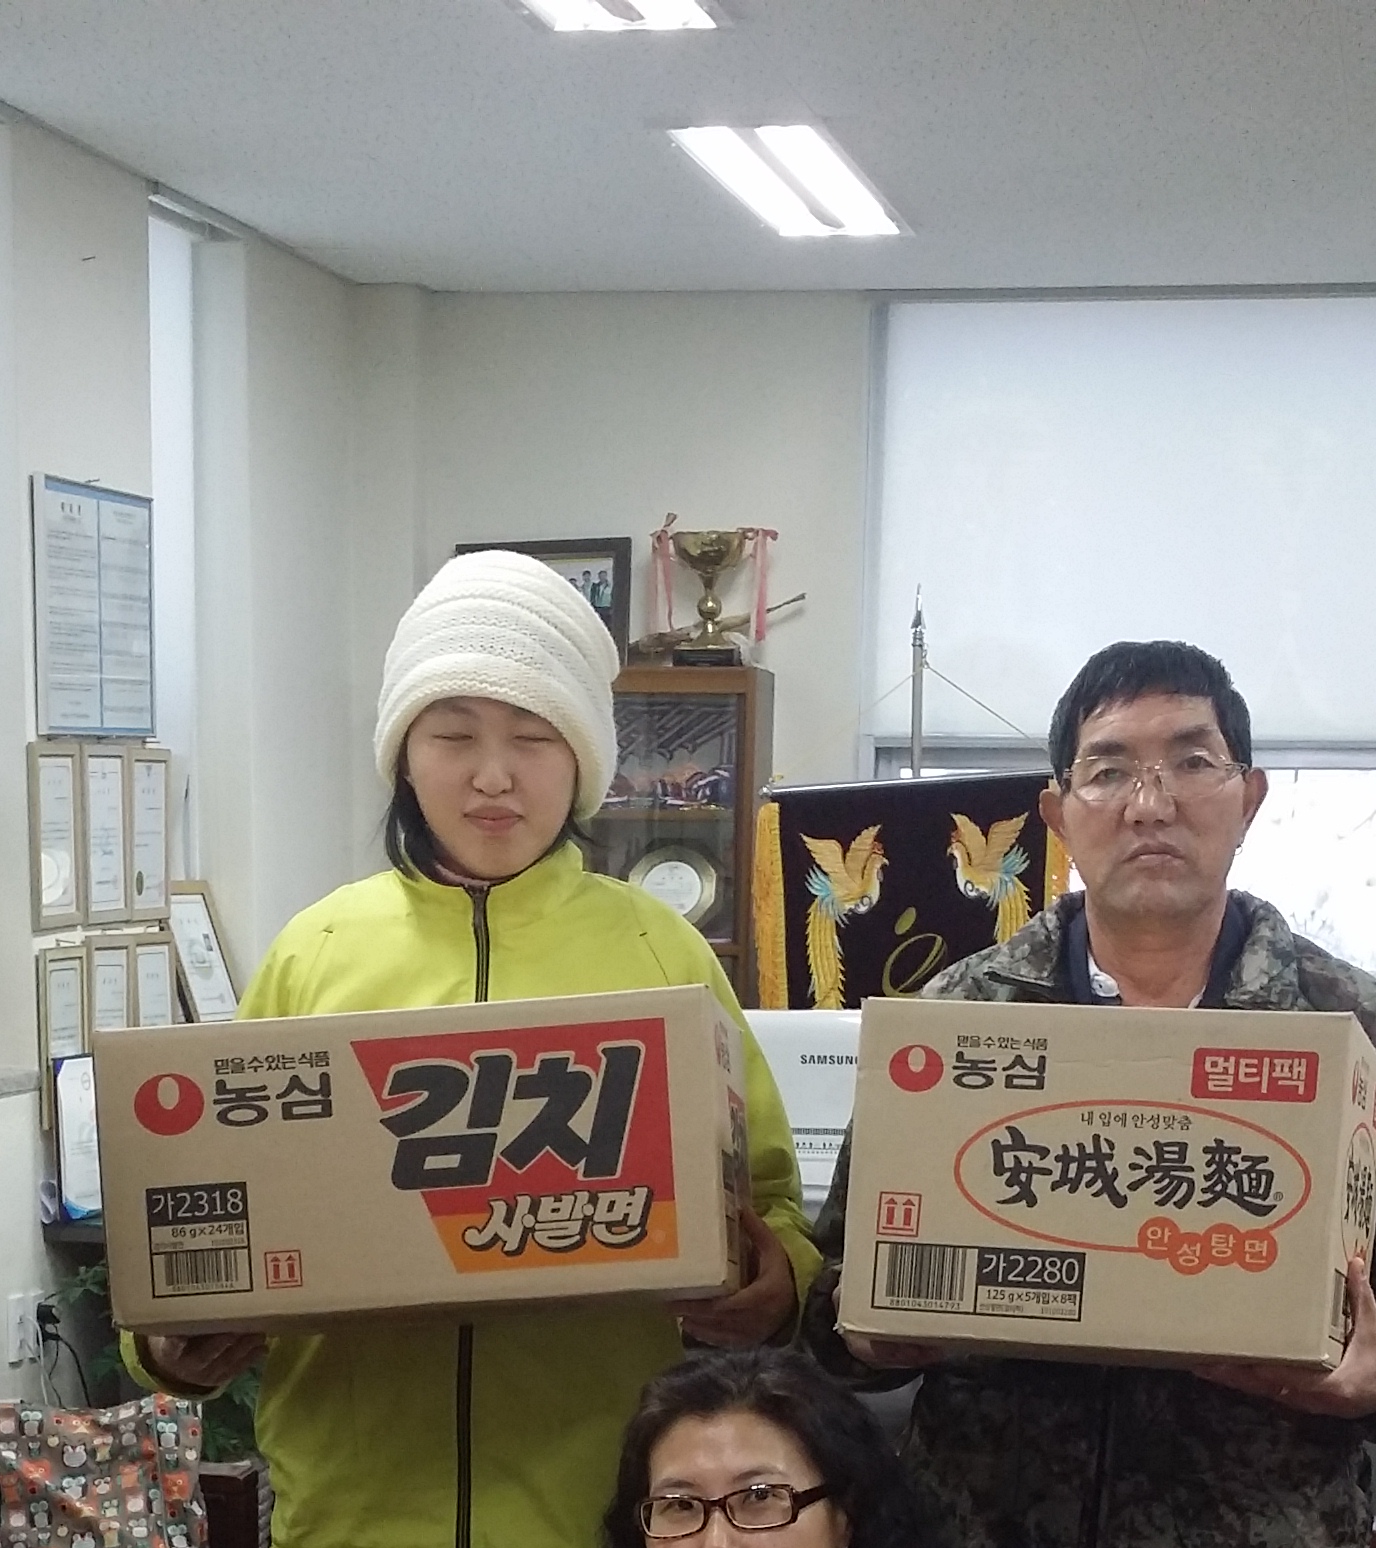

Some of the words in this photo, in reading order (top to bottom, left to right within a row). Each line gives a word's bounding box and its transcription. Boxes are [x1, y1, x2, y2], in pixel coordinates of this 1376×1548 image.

[800, 1054, 858, 1065] SAMSUN
[952, 1051, 1046, 1090] 농심
[1204, 1055, 1307, 1095] 멀티팩
[213, 1071, 333, 1127] 농심
[379, 1042, 644, 1191] 김치
[1081, 1111, 1094, 1127] 내
[1098, 1111, 1127, 1128] 입에
[1131, 1113, 1193, 1131] 안성맞춤
[990, 1126, 1279, 1218] 安城湯麵
[152, 1188, 244, 1221] 가2318
[462, 1185, 653, 1256] 사발면
[1146, 1226, 1268, 1266] 안성탕면
[982, 1252, 1080, 1285] 가2280
